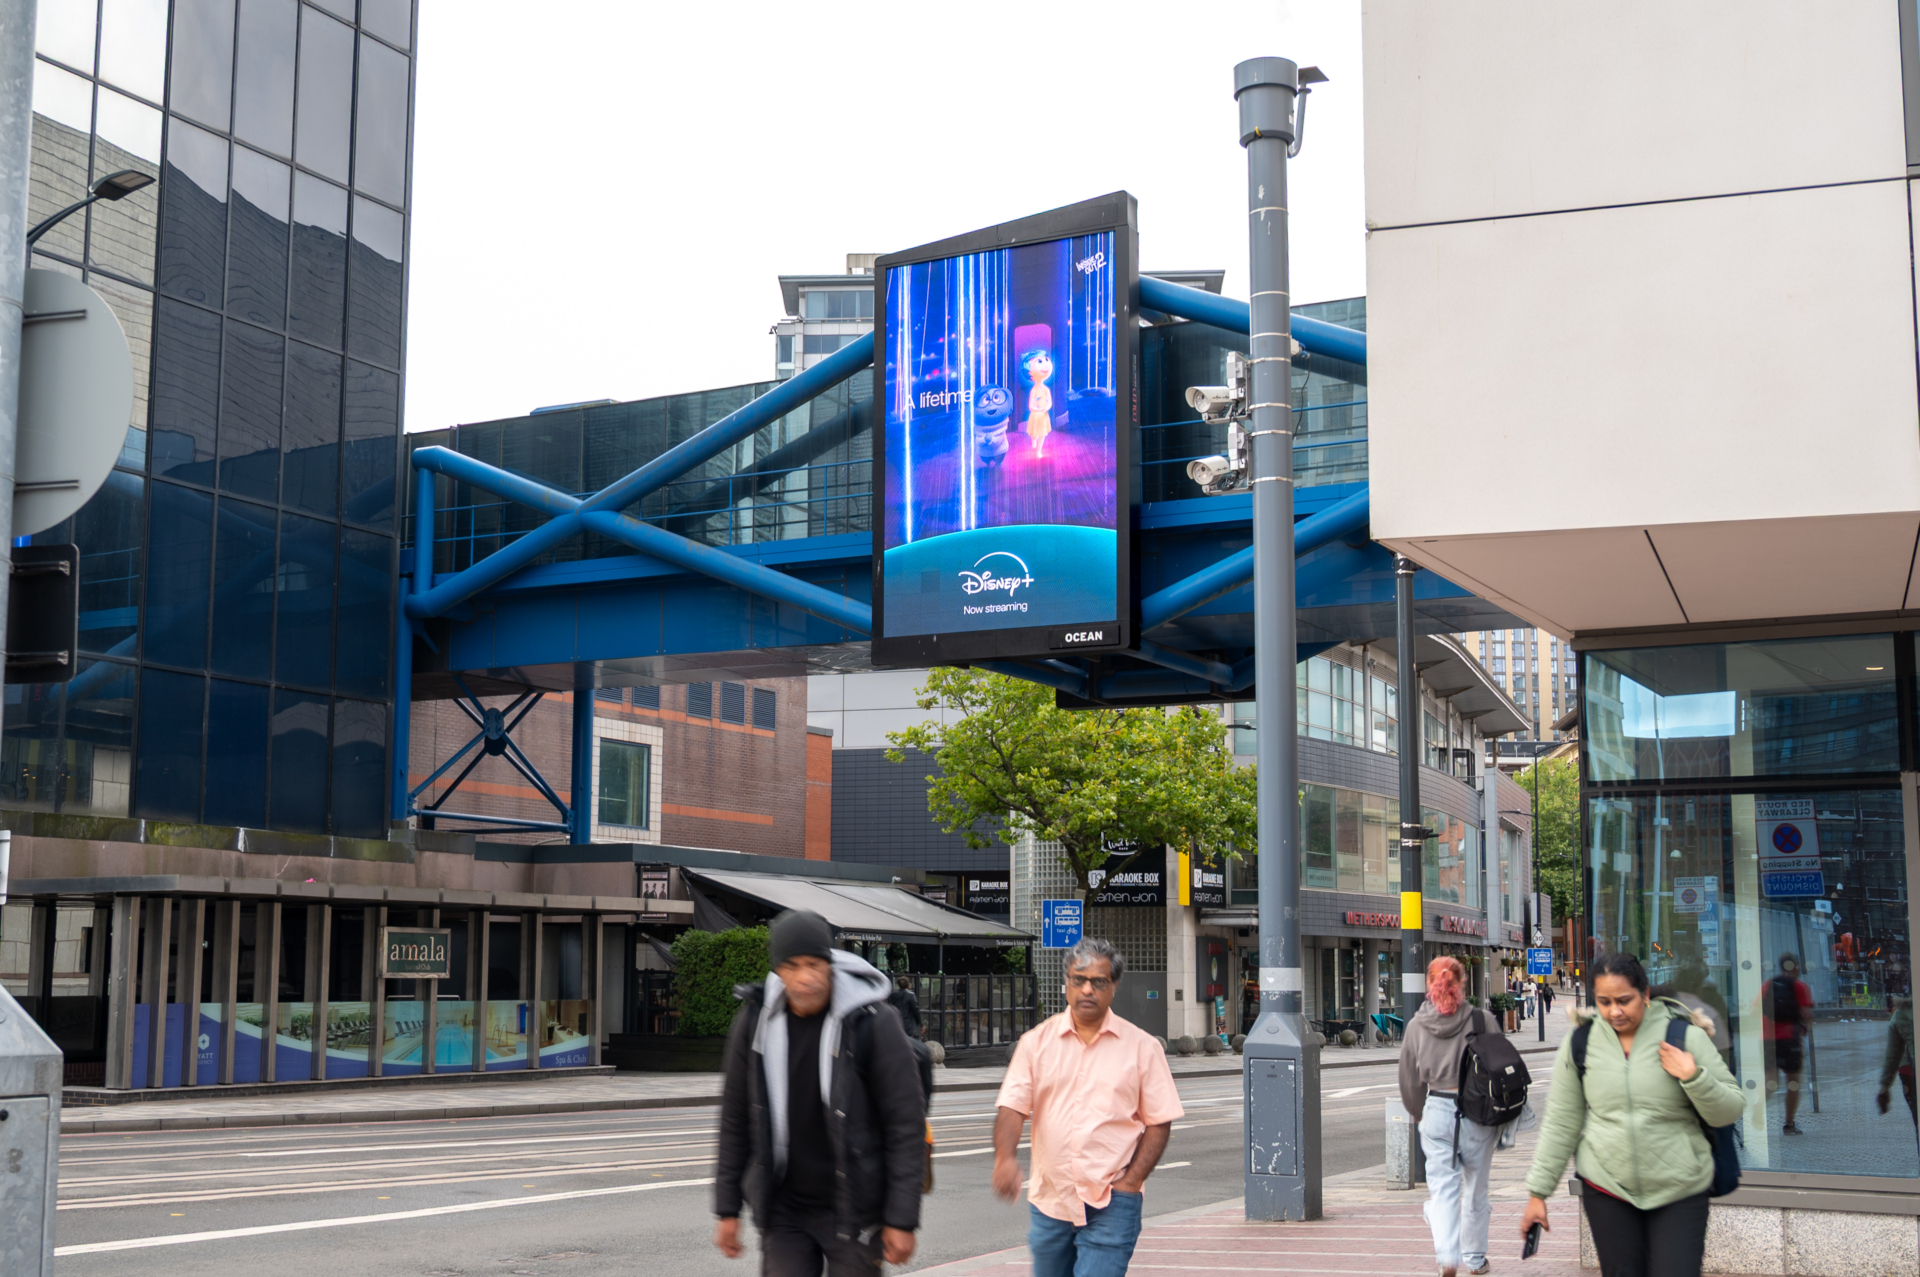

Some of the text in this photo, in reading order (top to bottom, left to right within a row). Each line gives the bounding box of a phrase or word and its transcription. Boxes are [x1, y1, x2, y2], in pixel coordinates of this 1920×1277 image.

[1084, 261, 1098, 275] OUT
[1095, 251, 1107, 268] 2
[903, 390, 972, 410] A lifetime
[963, 601, 1028, 615] Now streaming
[1064, 631, 1103, 643] OCEAN
[1144, 872, 1159, 883] BOX
[390, 936, 445, 961] amala
[555, 1054, 587, 1067] Spa & Club
